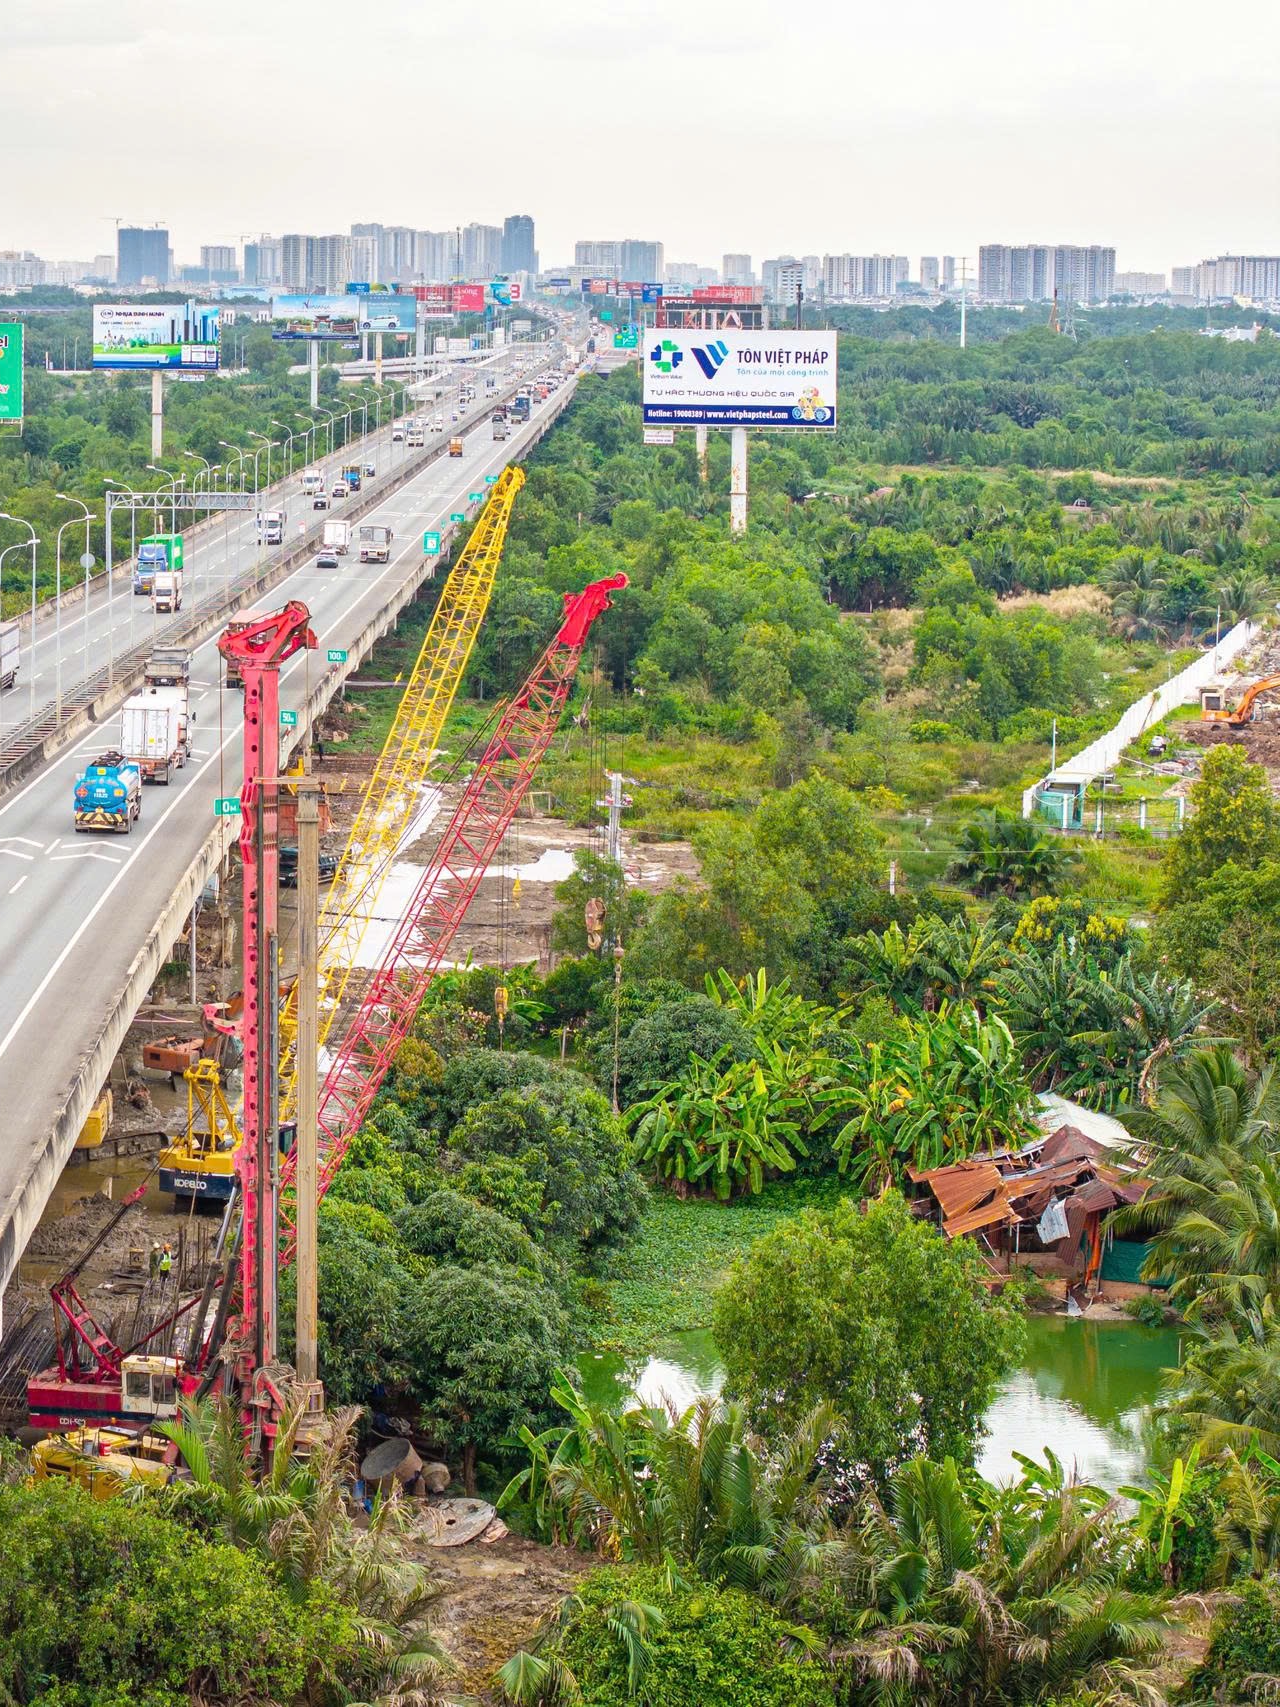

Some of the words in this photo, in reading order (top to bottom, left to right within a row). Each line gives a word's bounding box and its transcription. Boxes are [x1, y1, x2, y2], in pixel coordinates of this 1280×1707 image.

[737, 348, 761, 363] TÔN
[765, 349, 791, 367] VIỆT
[795, 349, 829, 364] PHÁP
[648, 409, 673, 418] Hotline:
[706, 410, 789, 420] www.vietphapsteel.com
